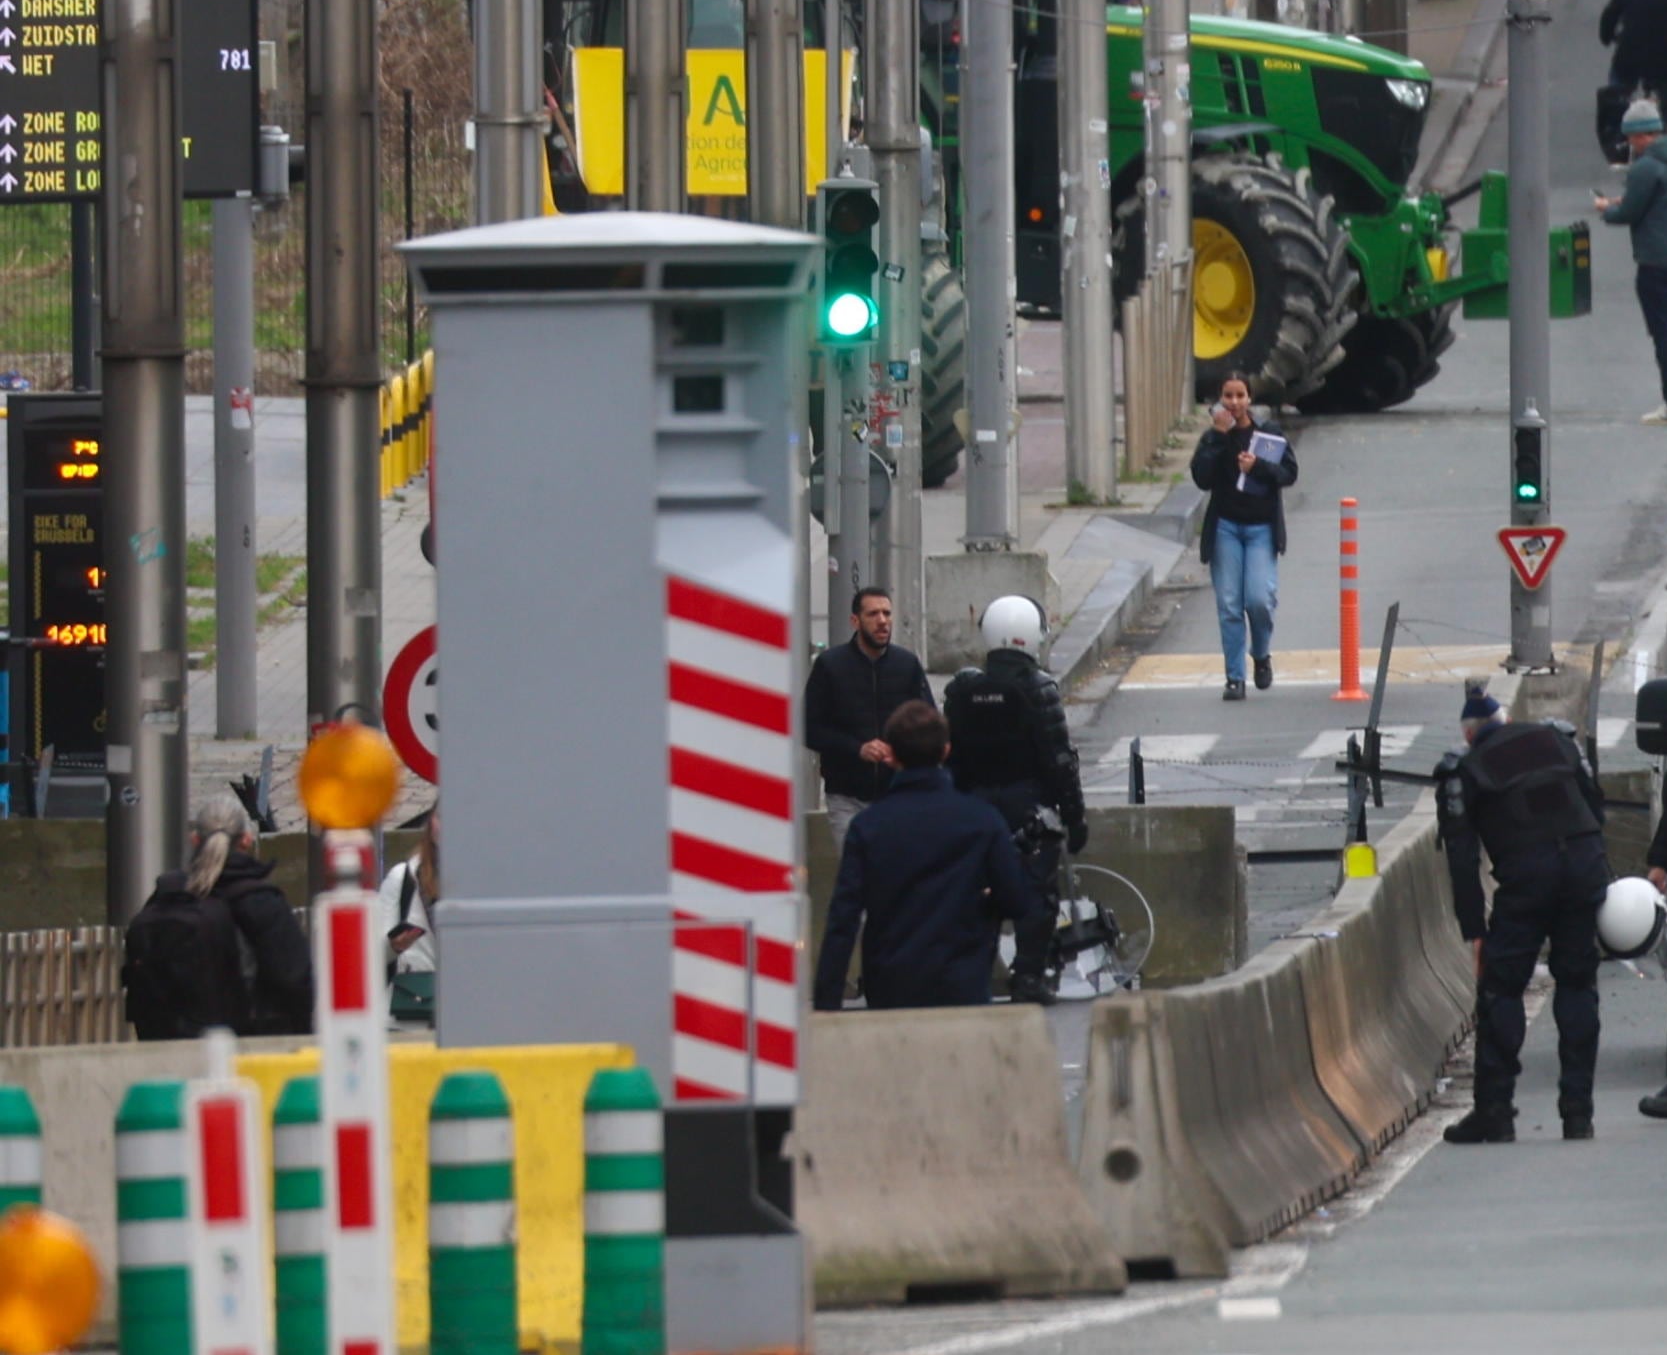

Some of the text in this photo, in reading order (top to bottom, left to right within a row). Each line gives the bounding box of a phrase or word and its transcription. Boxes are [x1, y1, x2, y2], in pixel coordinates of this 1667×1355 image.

[22, 25, 98, 47] ZUIDSTA
[220, 49, 252, 71] 781
[23, 112, 100, 133] ZONE RO
[24, 142, 100, 163] ZONE GR
[24, 170, 100, 191] ZONE LO
